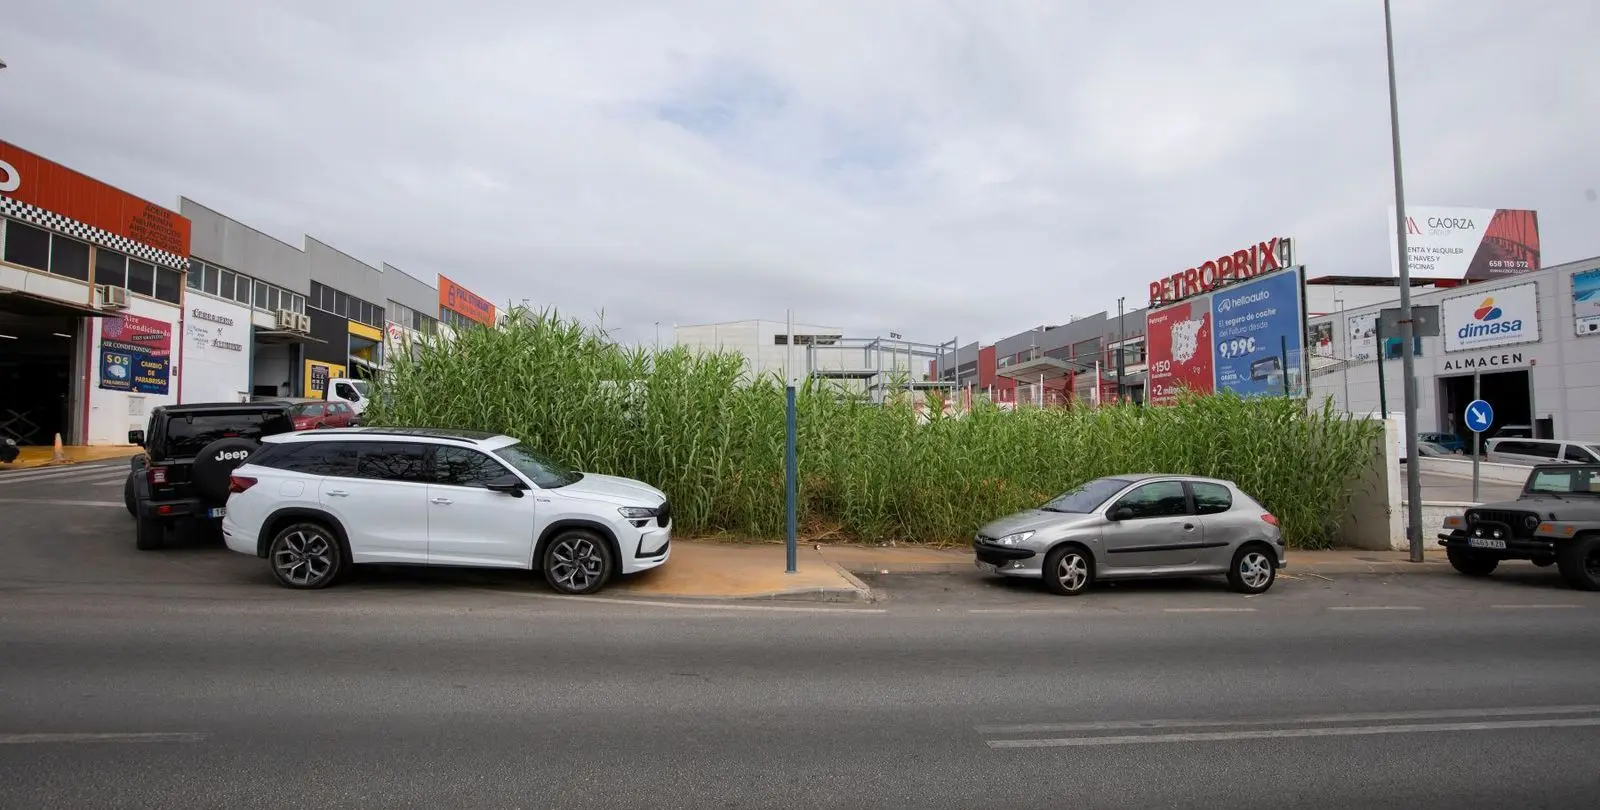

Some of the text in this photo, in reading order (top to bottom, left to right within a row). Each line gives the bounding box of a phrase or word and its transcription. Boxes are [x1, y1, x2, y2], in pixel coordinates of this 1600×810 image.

[1427, 217, 1475, 229] CAORZA
[1516, 260, 1529, 268] 572
[1150, 237, 1281, 305] PETROPRIX
[1231, 290, 1270, 308] helloauto
[123, 314, 139, 324] Aire
[1225, 316, 1245, 327] seguro
[1246, 312, 1255, 320] de
[1255, 308, 1277, 319] coche
[123, 321, 171, 337] Acondicionado
[1248, 321, 1269, 331] desde
[1458, 319, 1522, 339] dimasa
[113, 342, 152, 354] CONDITIONING
[1219, 337, 1256, 359] 9,99€
[106, 354, 129, 365] SOS
[140, 360, 163, 370] CAMBIO
[1444, 353, 1522, 370] ALMACEN
[1151, 360, 1171, 373] +150
[135, 375, 167, 386] PARABRISAS
[1152, 384, 1163, 396] +2
[214, 450, 249, 462] Jeep
